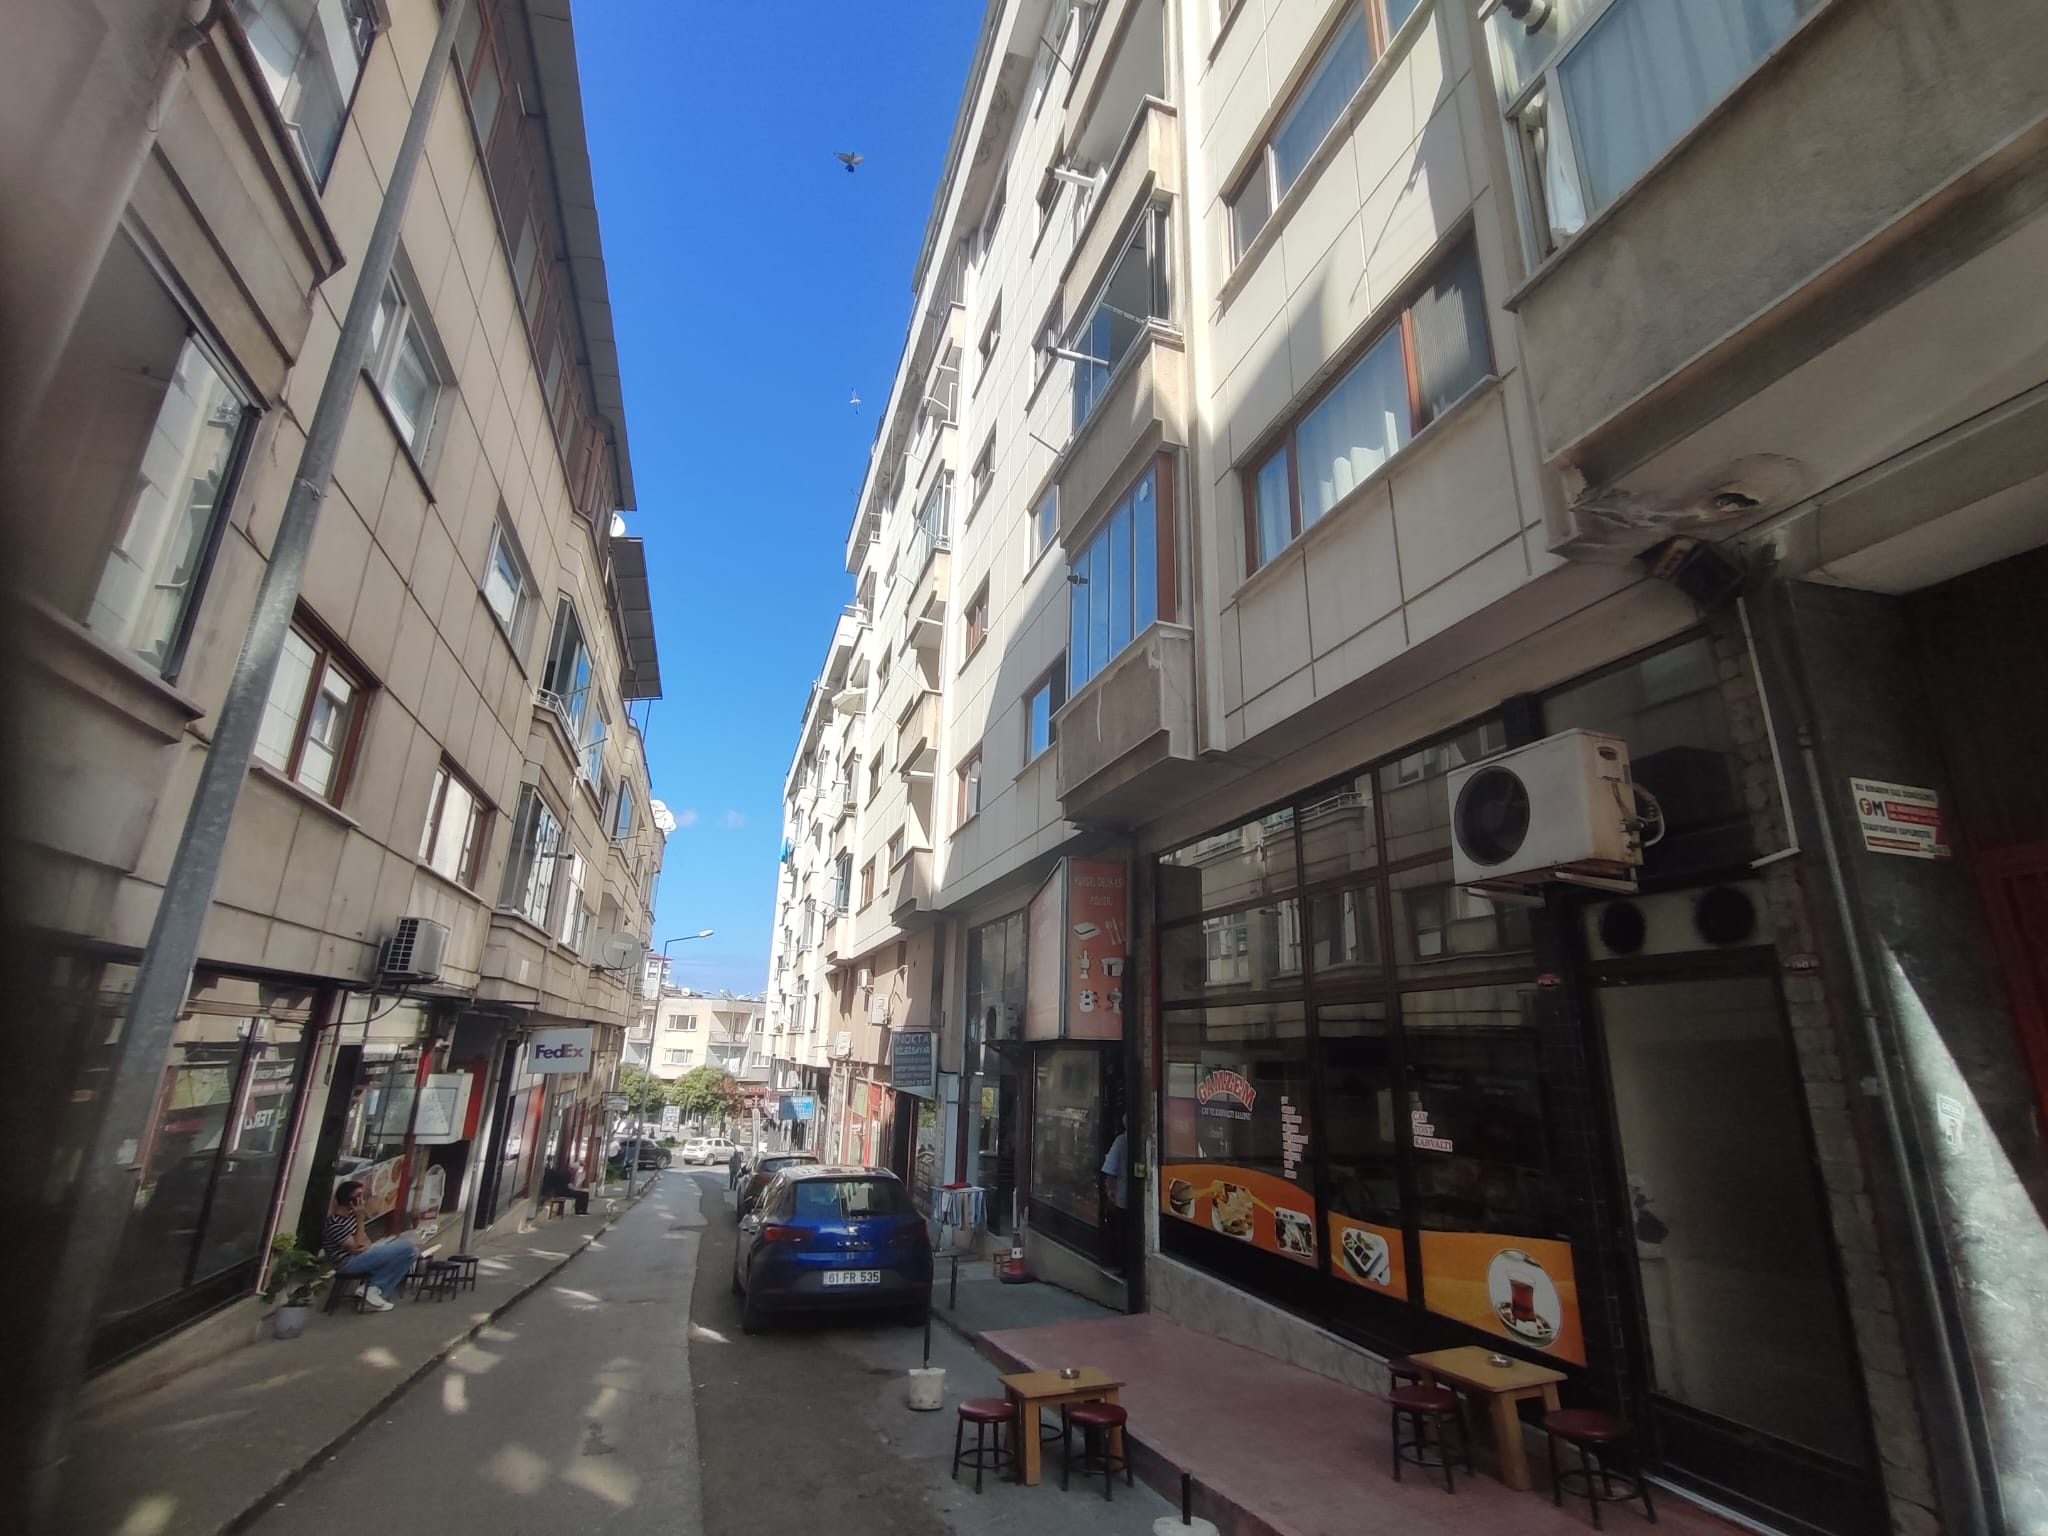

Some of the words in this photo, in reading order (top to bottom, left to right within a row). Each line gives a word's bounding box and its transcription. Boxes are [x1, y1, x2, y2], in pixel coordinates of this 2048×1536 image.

[896, 1034, 929, 1045] NOKTA
[535, 1043, 584, 1059] FedEx
[1198, 1070, 1256, 1112] GAMZEM
[1414, 1124, 1433, 1135] TOST
[1415, 1137, 1452, 1150] KAHVALTI
[828, 1272, 839, 1283] 61
[843, 1272, 856, 1282] FR
[860, 1271, 879, 1282] 535
